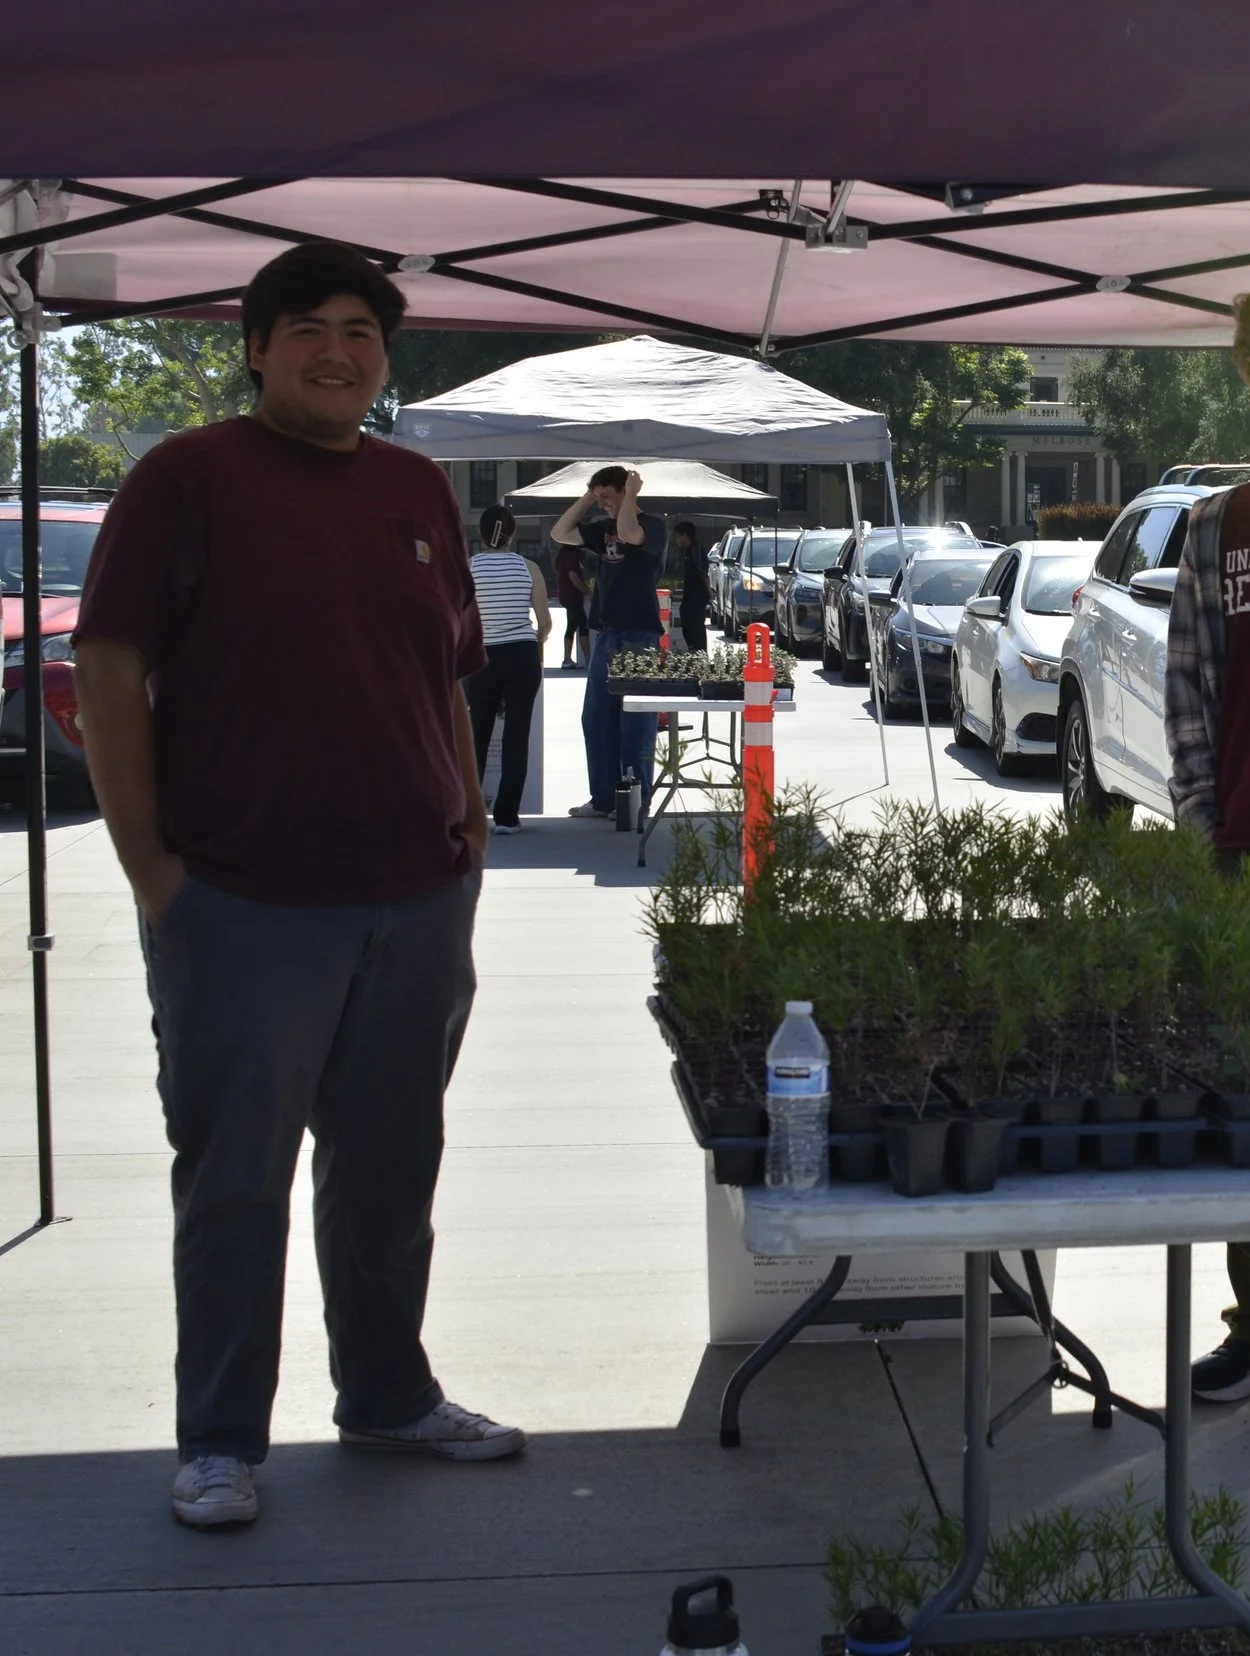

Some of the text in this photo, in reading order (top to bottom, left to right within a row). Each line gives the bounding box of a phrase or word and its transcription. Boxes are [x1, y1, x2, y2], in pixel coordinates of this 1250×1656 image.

[1032, 436, 1091, 446] MELROSE
[898, 1275, 945, 1283] structures
[890, 1283, 915, 1291] other
